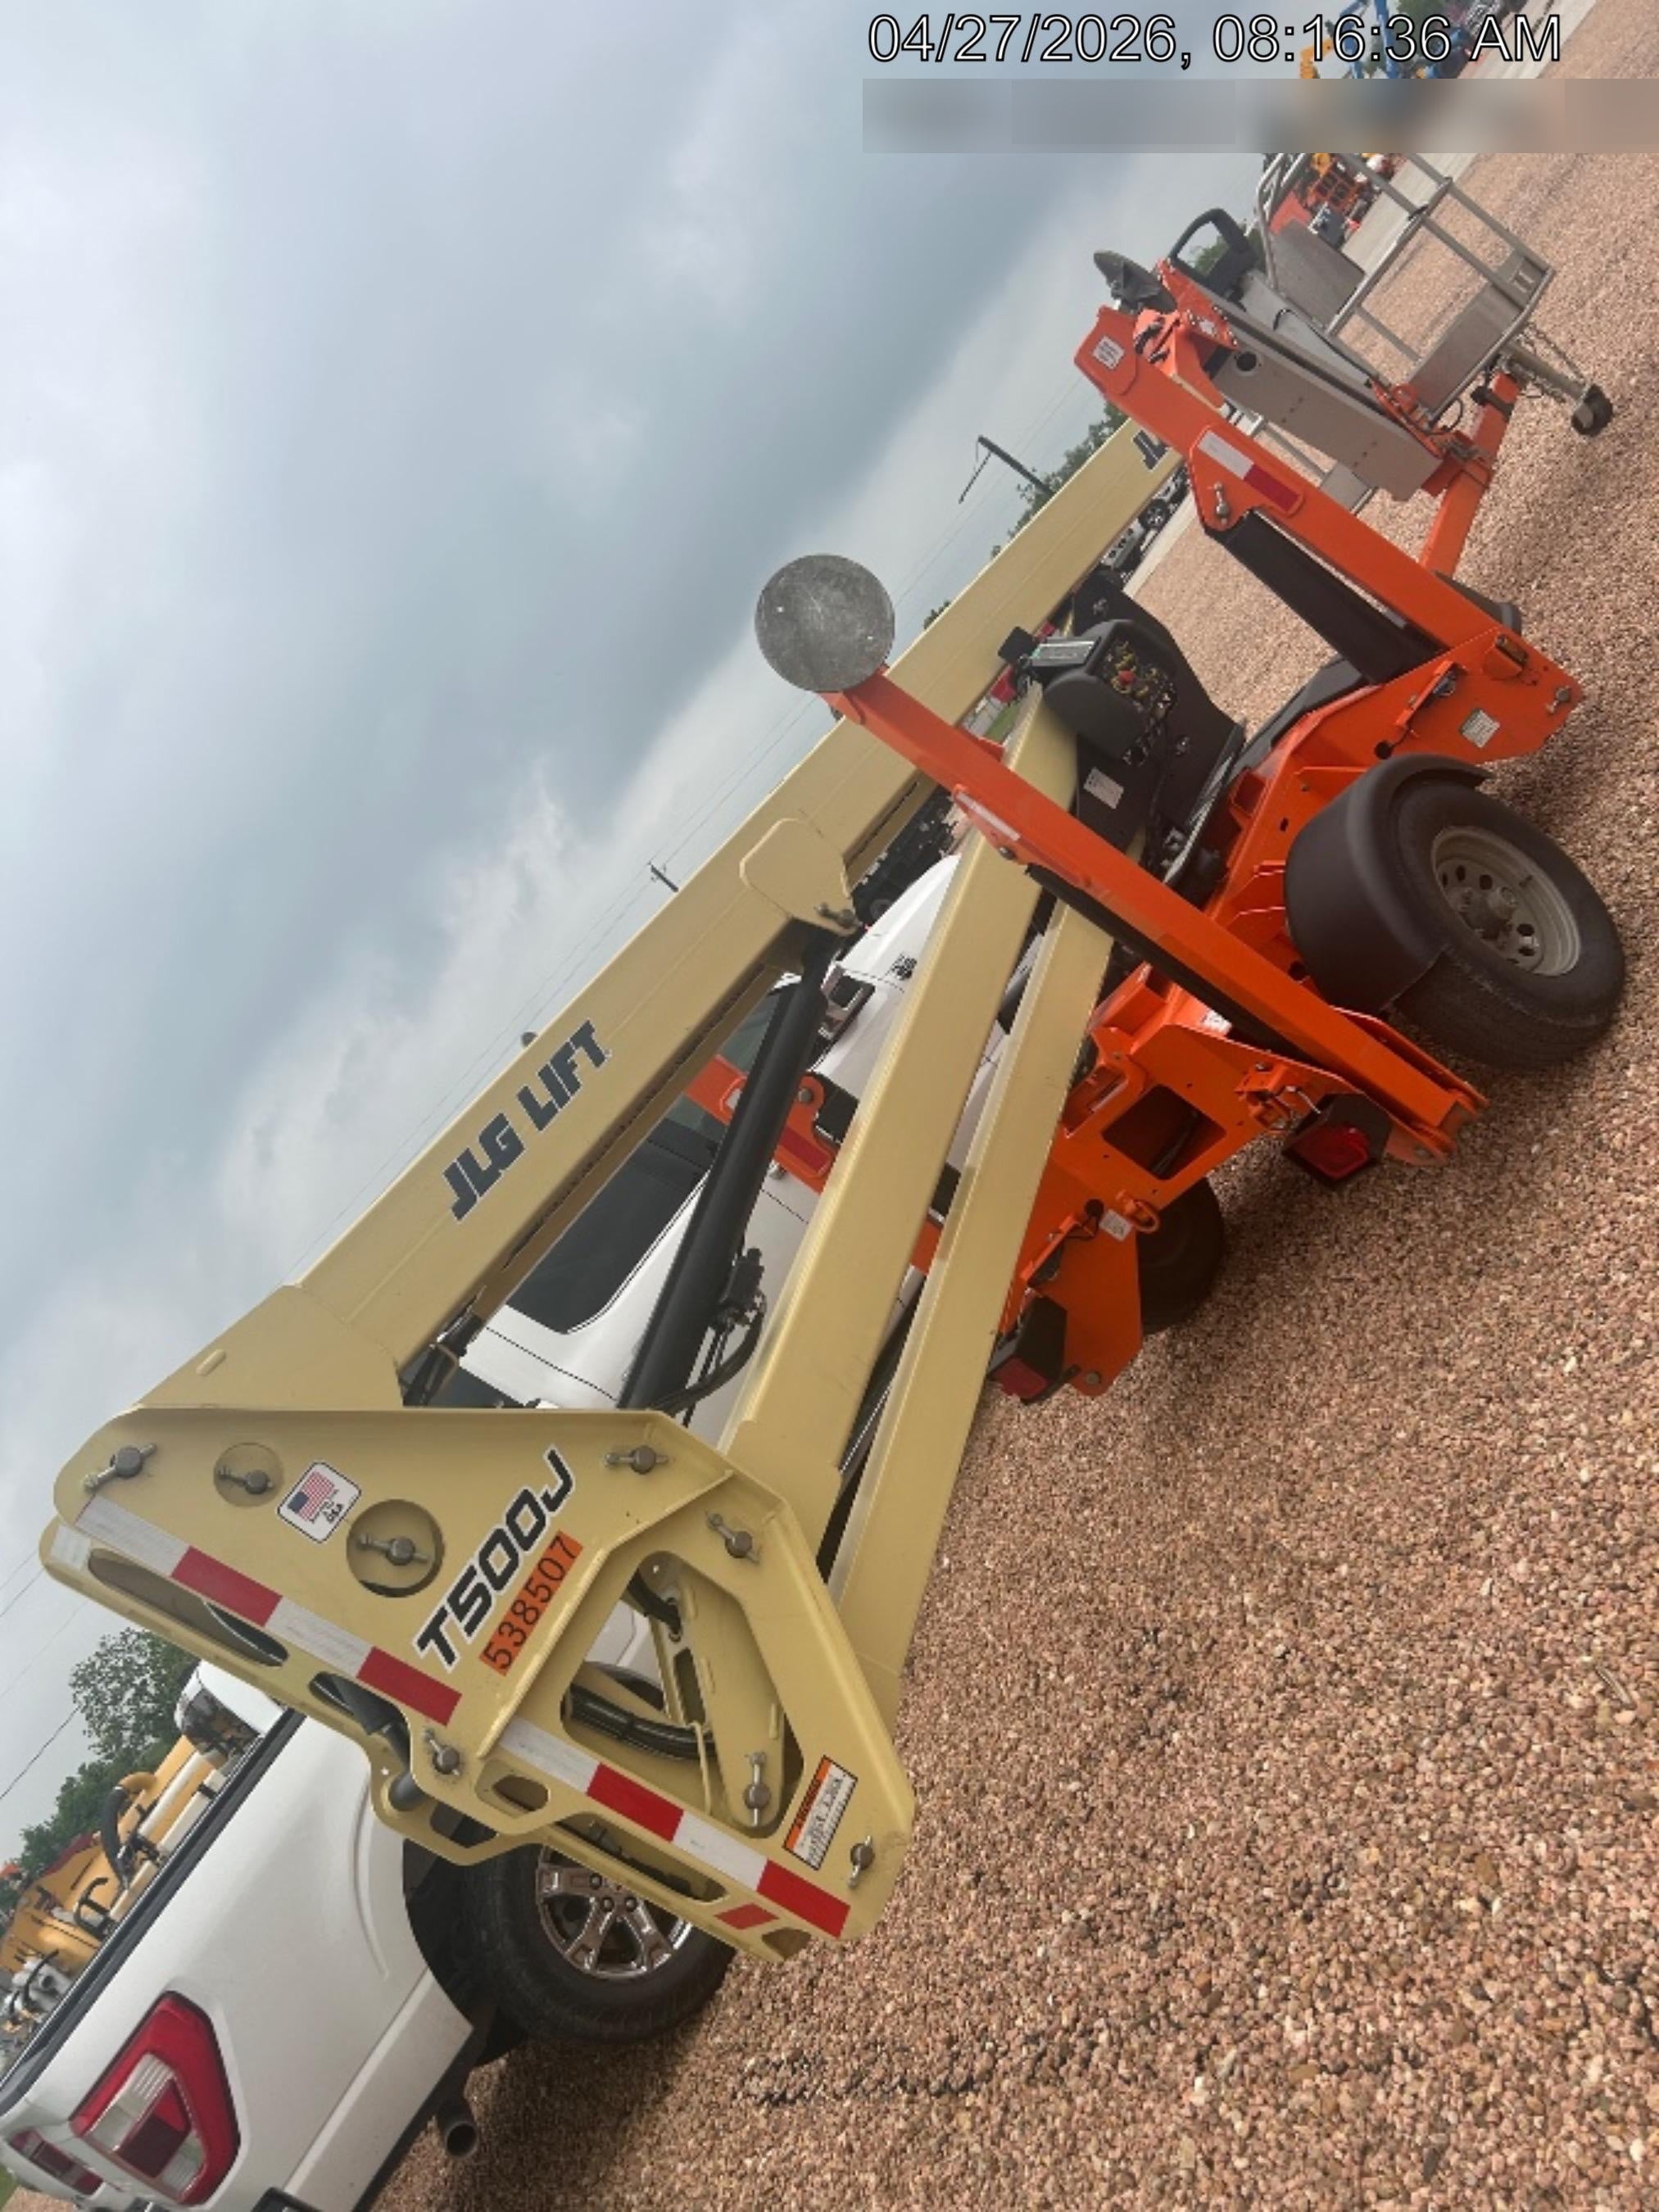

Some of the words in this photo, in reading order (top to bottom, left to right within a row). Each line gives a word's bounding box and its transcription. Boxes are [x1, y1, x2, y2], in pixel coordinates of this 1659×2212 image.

[1132, 428, 1169, 470] JL
[442, 1113, 526, 1222] JLG
[516, 1019, 607, 1133] LIFT
[415, 1446, 574, 1670] T500J
[483, 1534, 576, 1669] 538507
